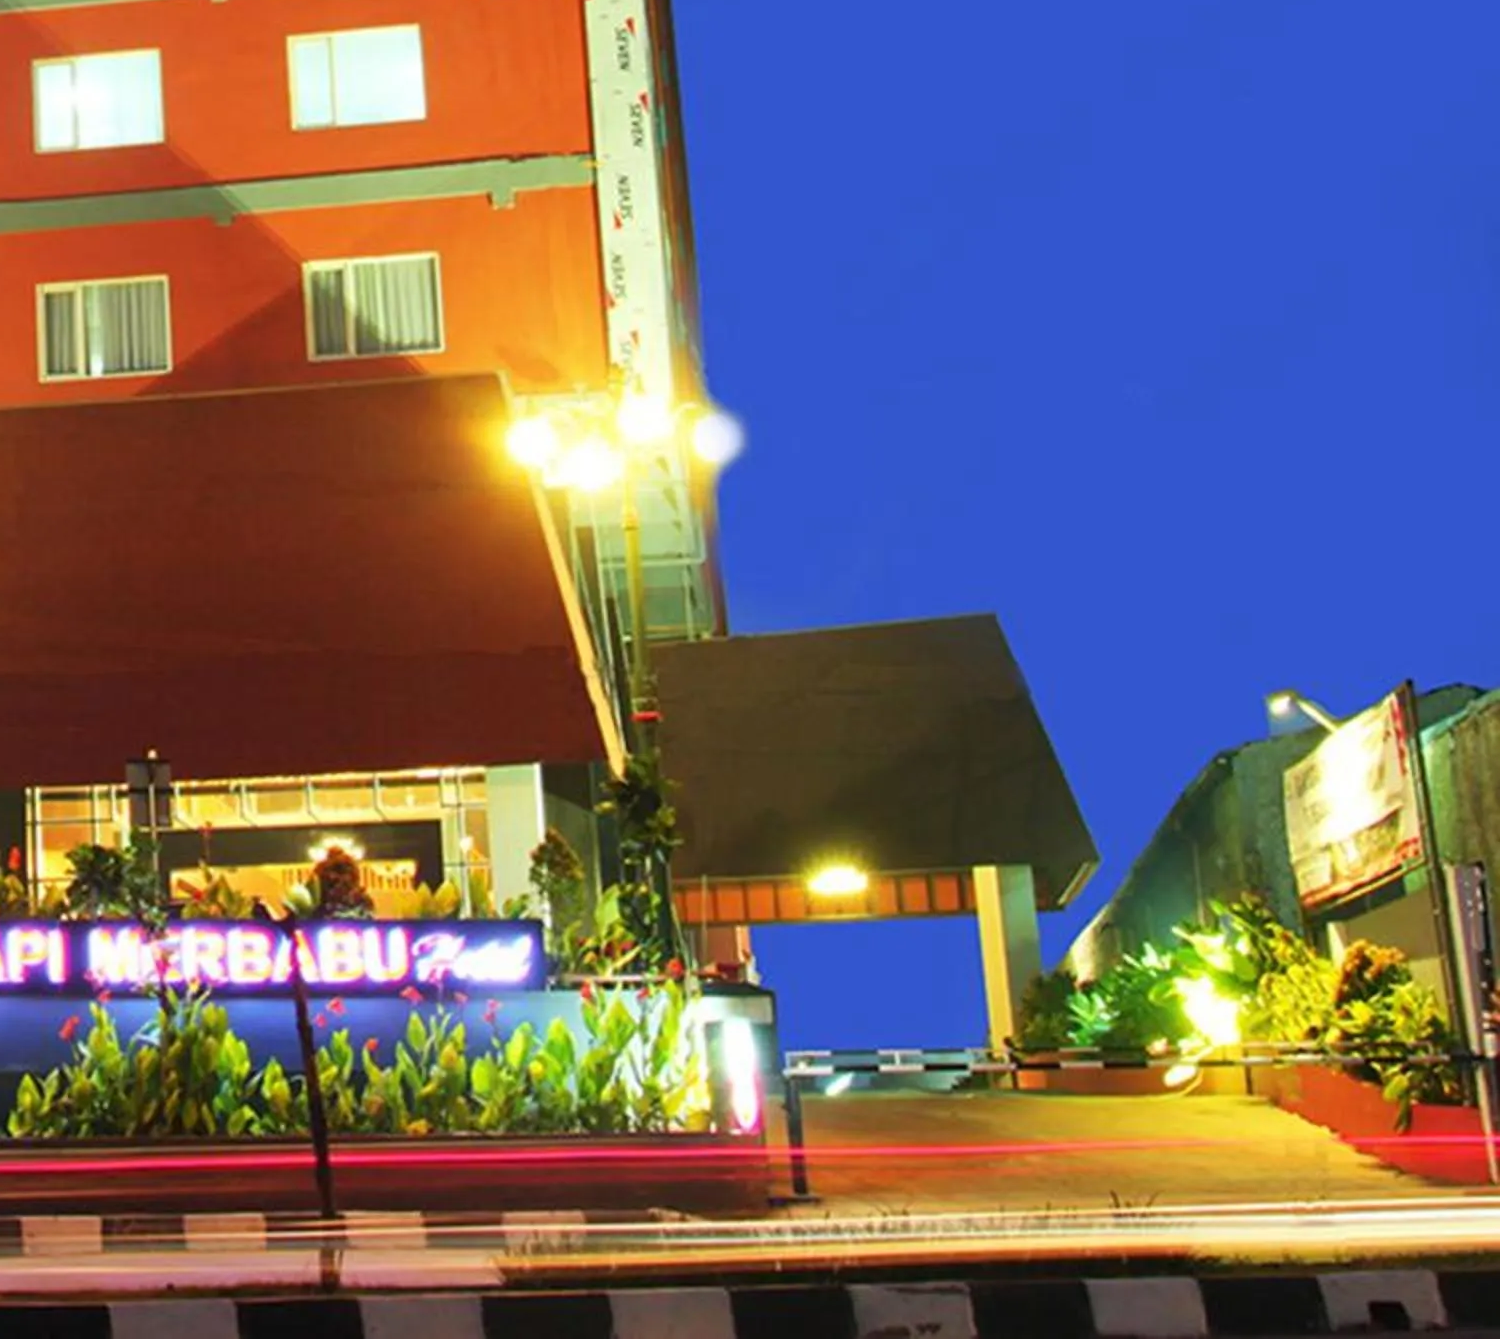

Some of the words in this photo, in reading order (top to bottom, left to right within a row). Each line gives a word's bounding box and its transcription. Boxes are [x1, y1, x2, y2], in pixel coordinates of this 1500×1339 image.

[614, 27, 630, 71] SEVEN
[628, 103, 644, 147] SEVEN
[617, 175, 634, 219] SEVEN
[611, 254, 628, 298] SEVEN
[88, 925, 409, 984] MERBABU
